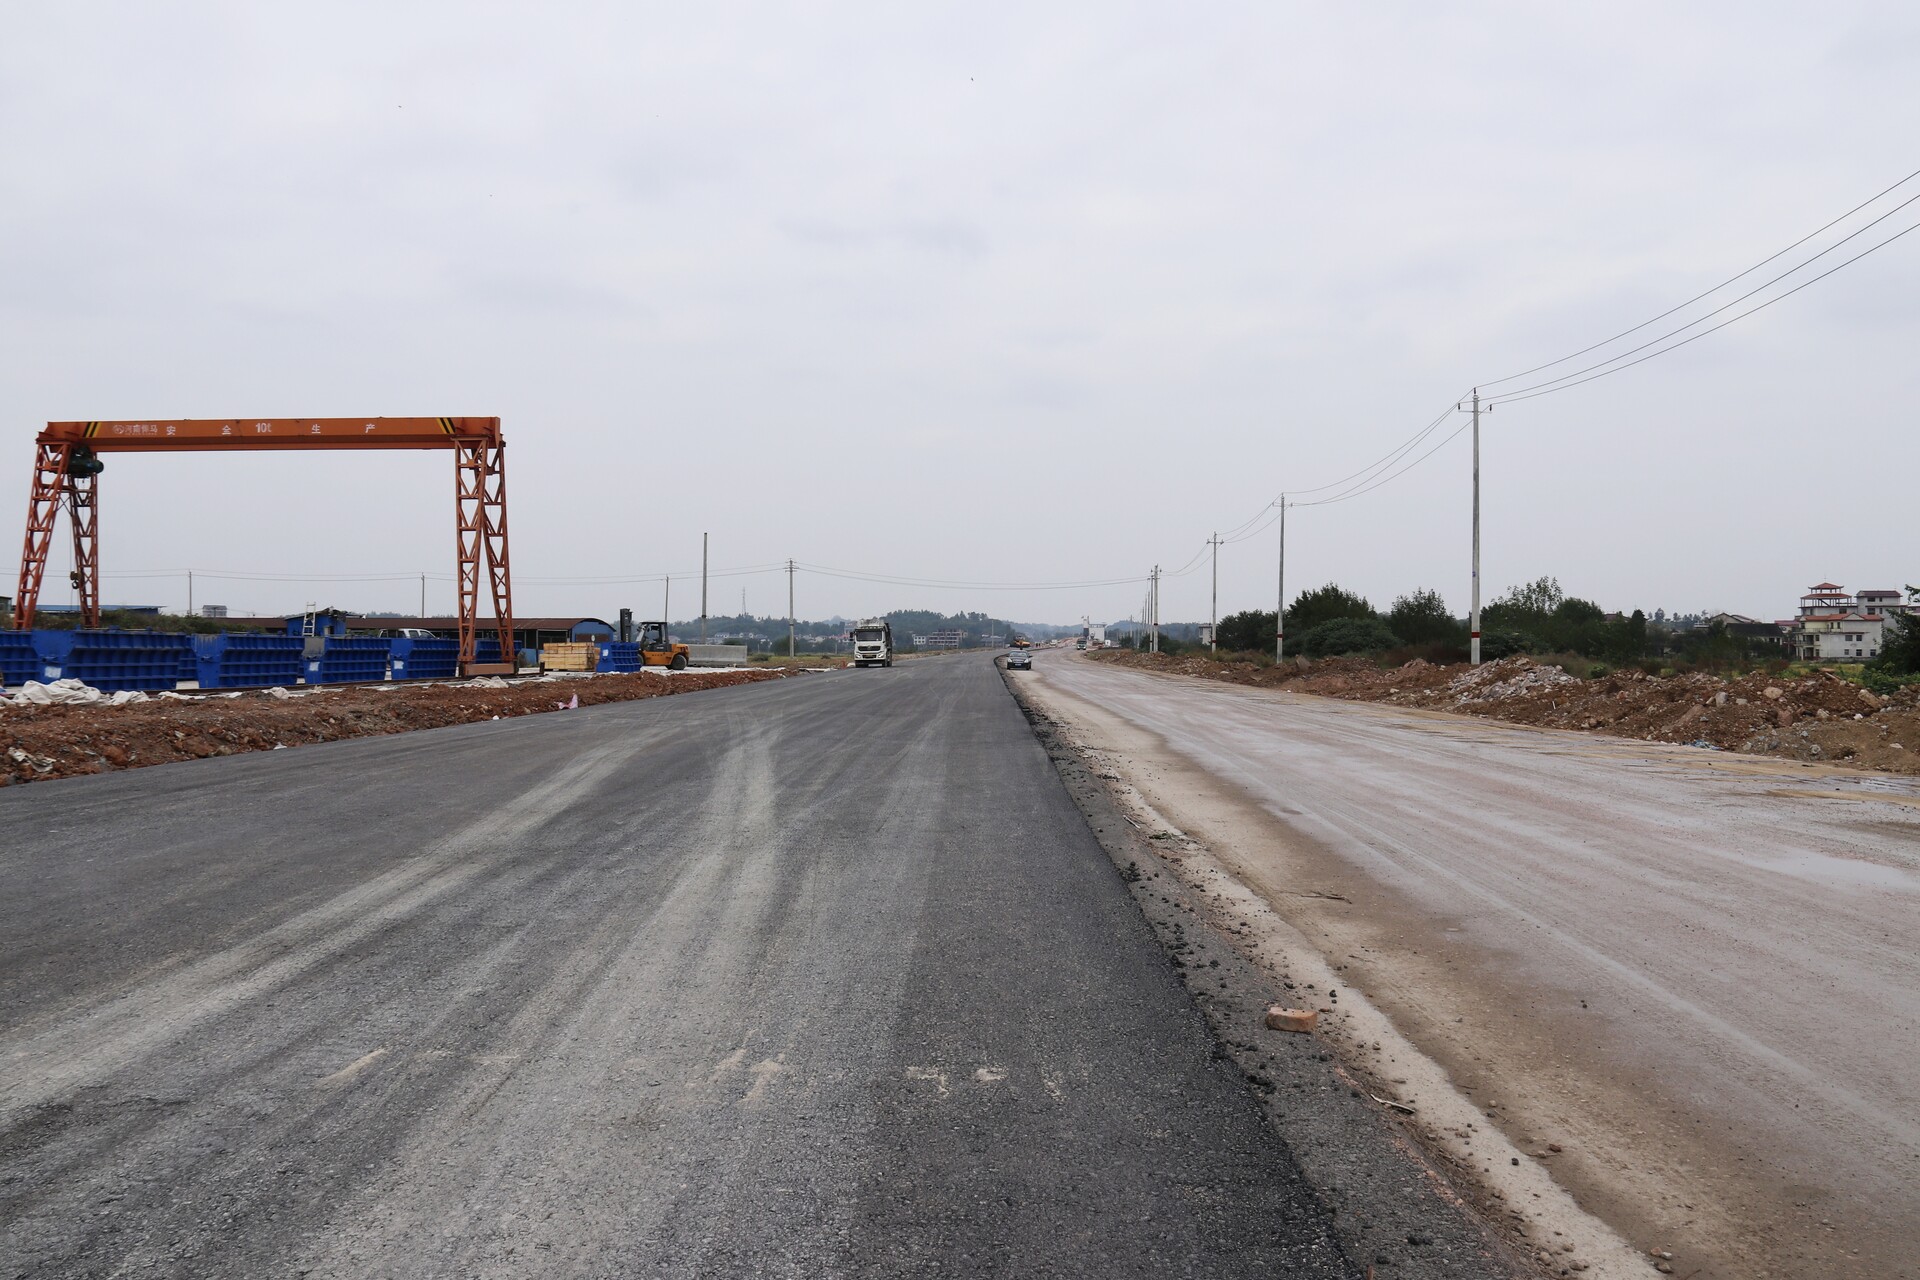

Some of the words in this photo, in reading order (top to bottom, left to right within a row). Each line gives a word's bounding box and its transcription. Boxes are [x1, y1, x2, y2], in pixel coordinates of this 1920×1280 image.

[166, 425, 176, 436] 安
[222, 424, 232, 436] 全
[255, 422, 272, 433] 10t
[311, 423, 322, 434] 生
[365, 422, 376, 434] 产
